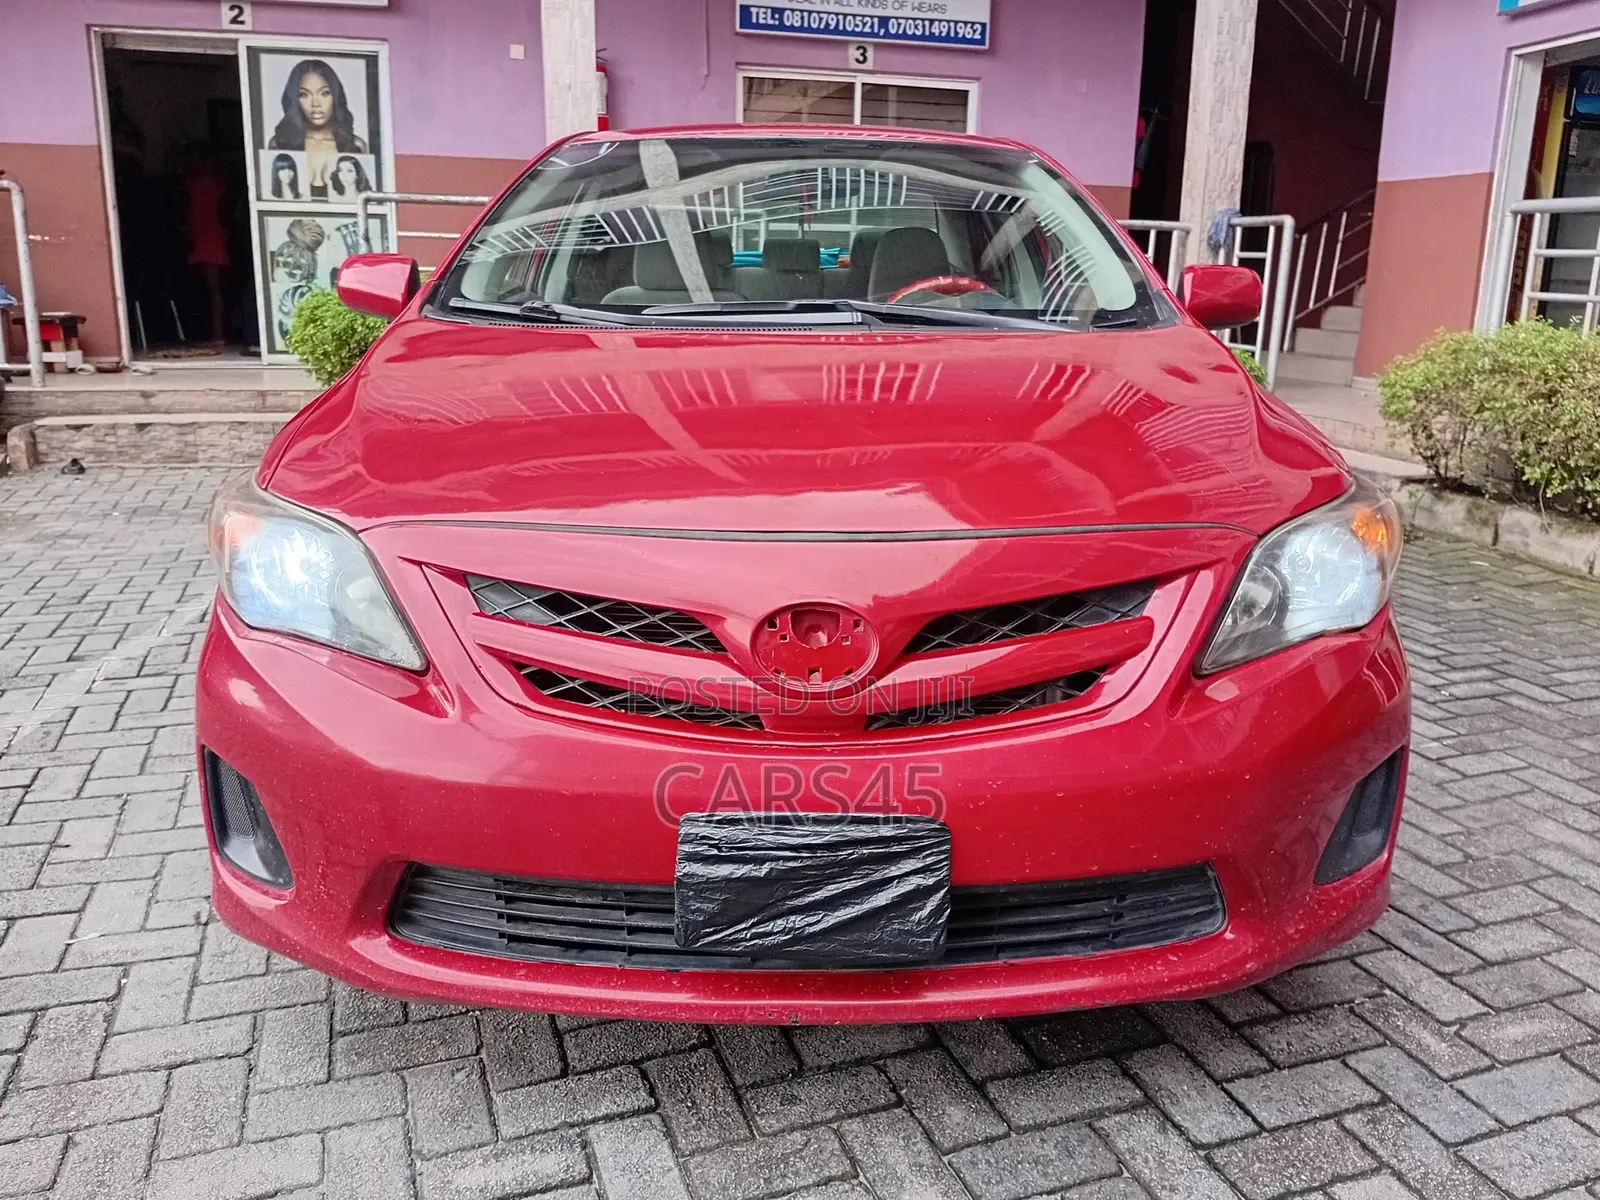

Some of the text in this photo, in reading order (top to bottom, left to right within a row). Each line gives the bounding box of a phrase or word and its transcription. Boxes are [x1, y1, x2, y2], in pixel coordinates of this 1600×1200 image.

[228, 4, 246, 25] 2
[857, 0, 888, 10] KINDS
[891, 0, 908, 11] OF
[911, 1, 948, 15] WEARS
[750, 7, 982, 39] TEL: 08107910521, 07031491962
[854, 45, 868, 65] 3
